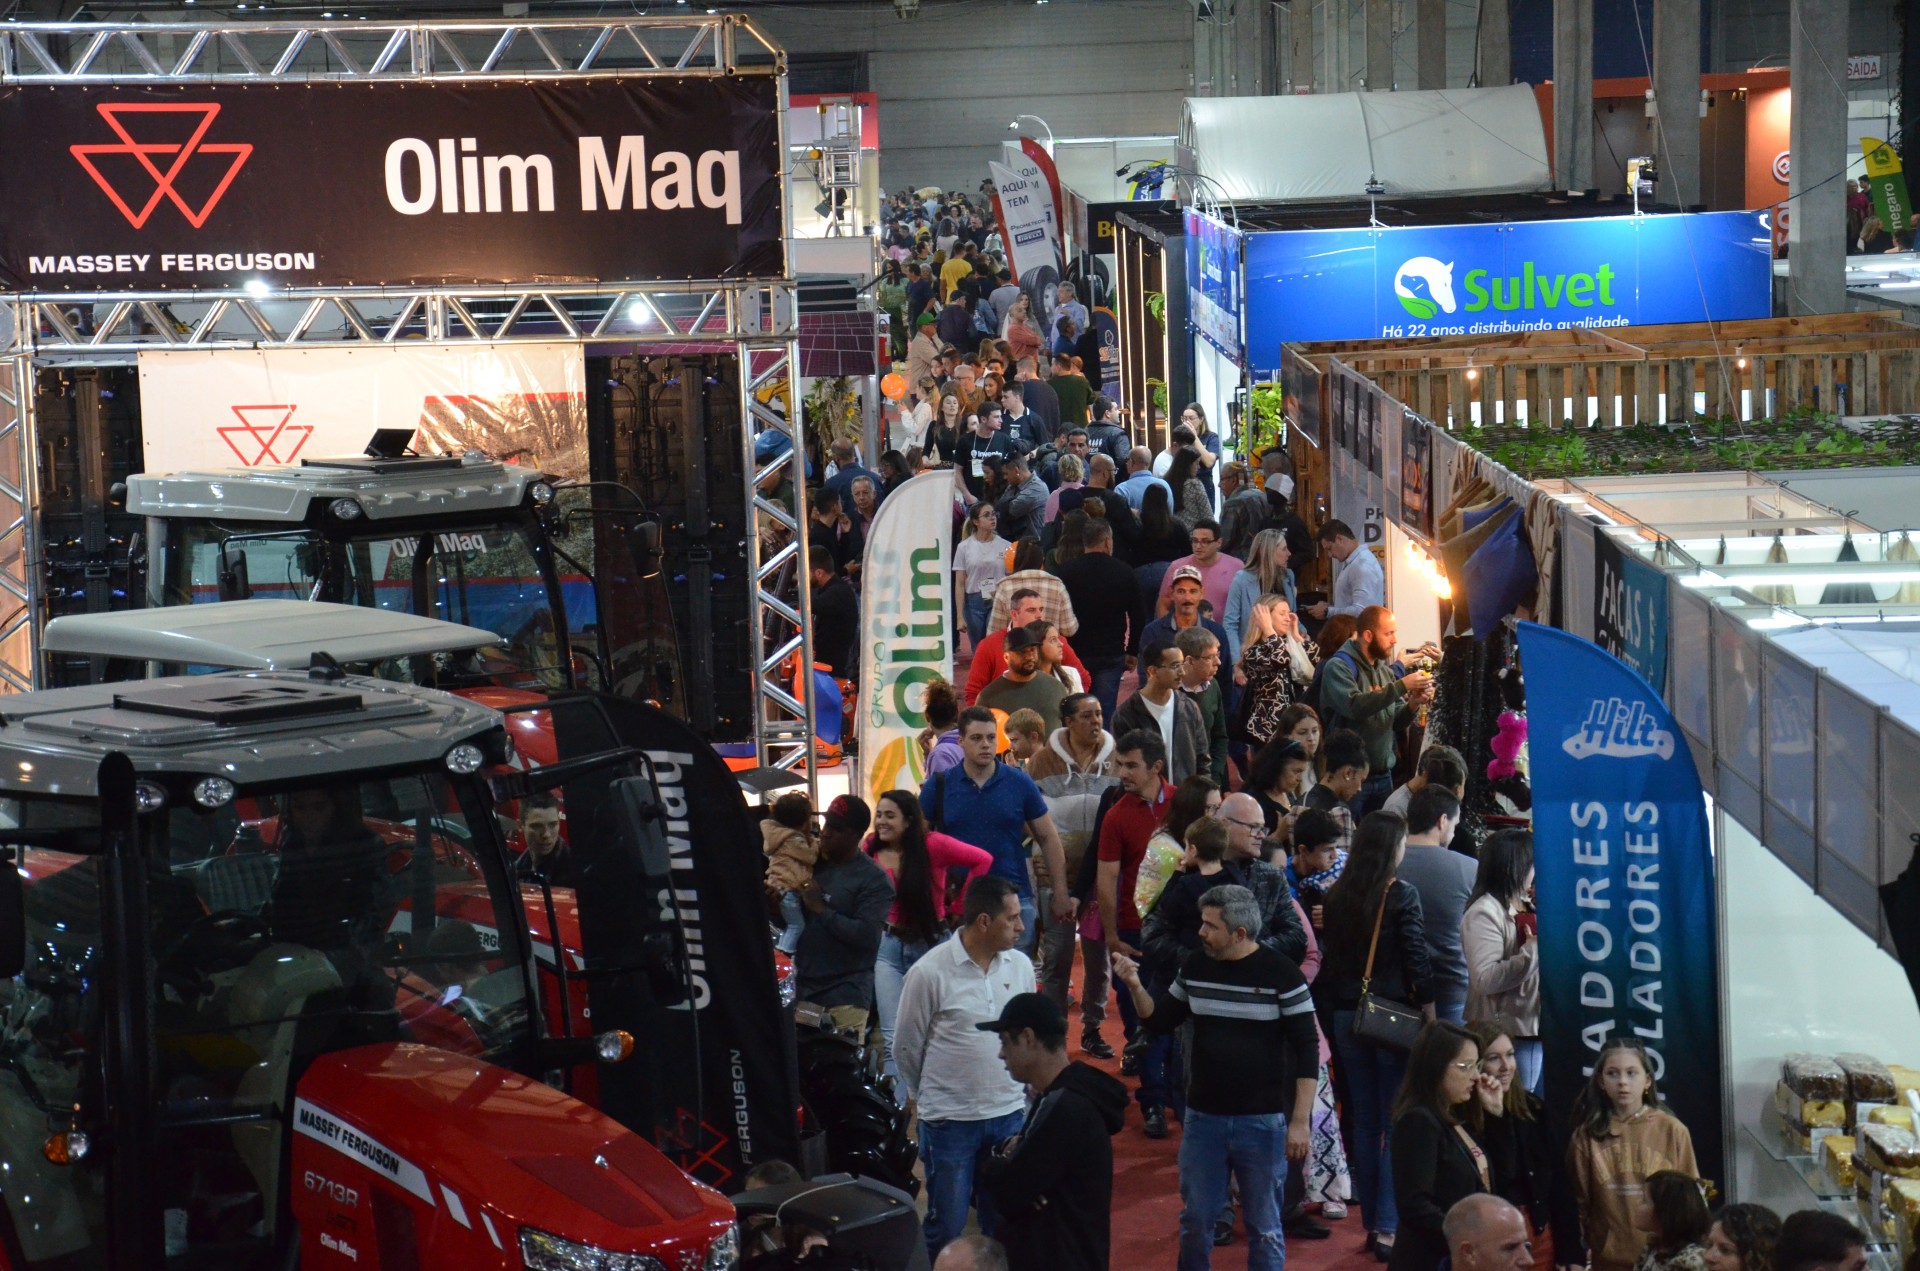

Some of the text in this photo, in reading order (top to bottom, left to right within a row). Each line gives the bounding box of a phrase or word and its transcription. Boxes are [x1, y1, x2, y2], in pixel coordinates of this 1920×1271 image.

[384, 135, 742, 225] Olim Maq
[1002, 180, 1027, 195] AQUI
[1007, 194, 1029, 208] TEM
[1097, 220, 1116, 238] B
[29, 252, 315, 274] MASSEY FERGUSON
[1463, 261, 1615, 312] Sulvet
[1382, 325, 1404, 338] Há
[1408, 324, 1427, 337] 22
[1430, 325, 1465, 337] anos
[1469, 319, 1553, 335] distribuindo
[439, 532, 487, 554] Maq
[870, 641, 886, 729] GRUPO
[1581, 697, 1658, 749] Hilt
[1569, 801, 1617, 1077] ADORES
[729, 1048, 753, 1165] FERGUSON
[300, 1108, 400, 1176] MASSEY FERGUSON
[304, 1170, 359, 1209] 6713R
[338, 1239, 358, 1263] Maq
